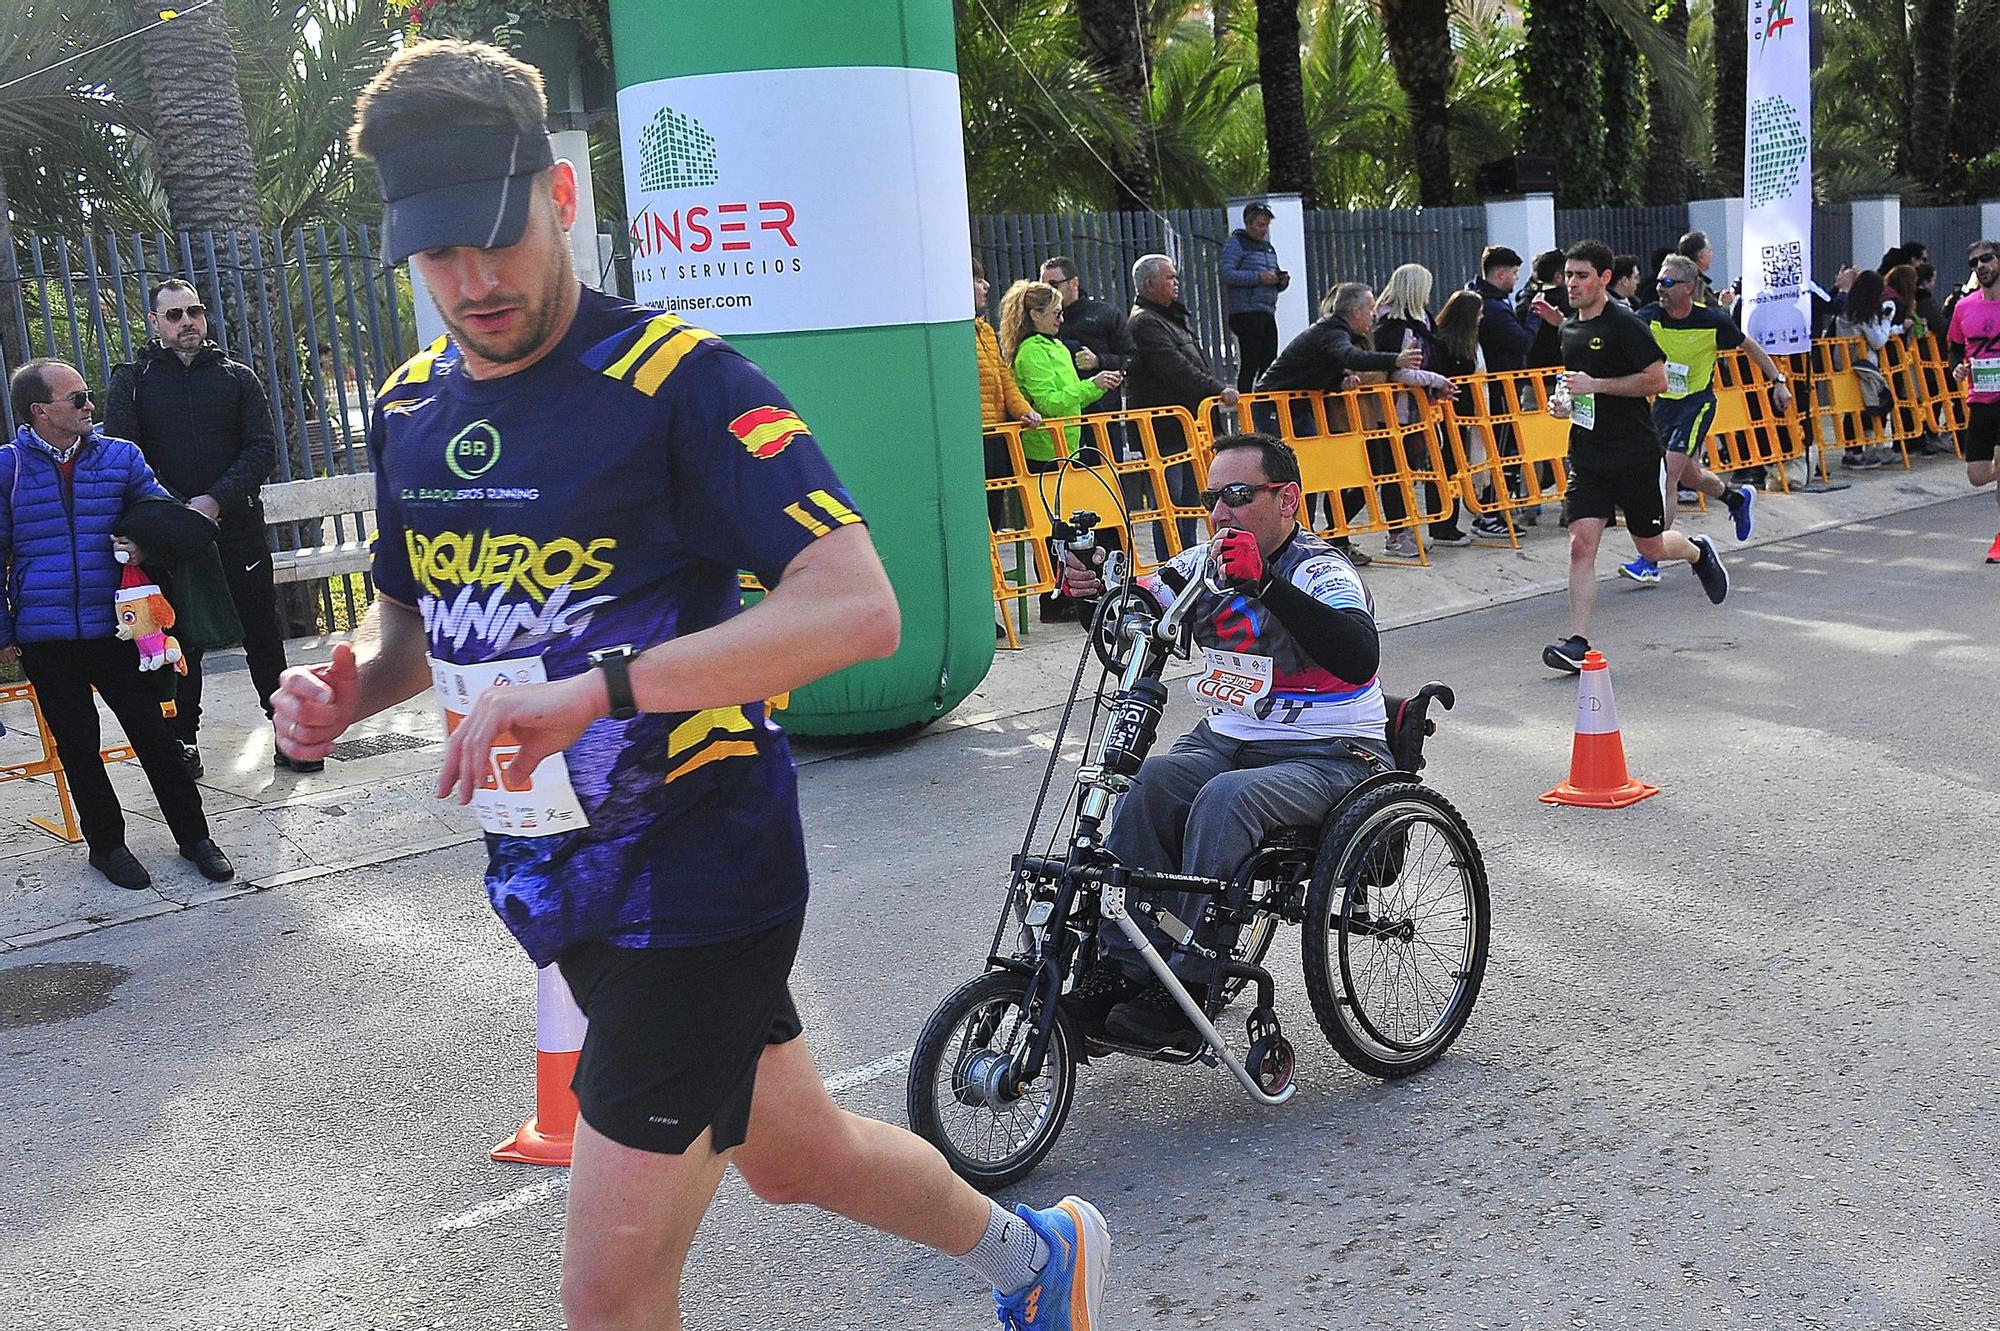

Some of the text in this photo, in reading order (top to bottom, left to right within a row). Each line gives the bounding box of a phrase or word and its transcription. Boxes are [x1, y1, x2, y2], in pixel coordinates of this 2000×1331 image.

[660, 266, 667, 280] Y
[678, 258, 801, 279] SERVICIOS
[459, 441, 487, 456] BR
[649, 1116, 679, 1126] KIPRUN
